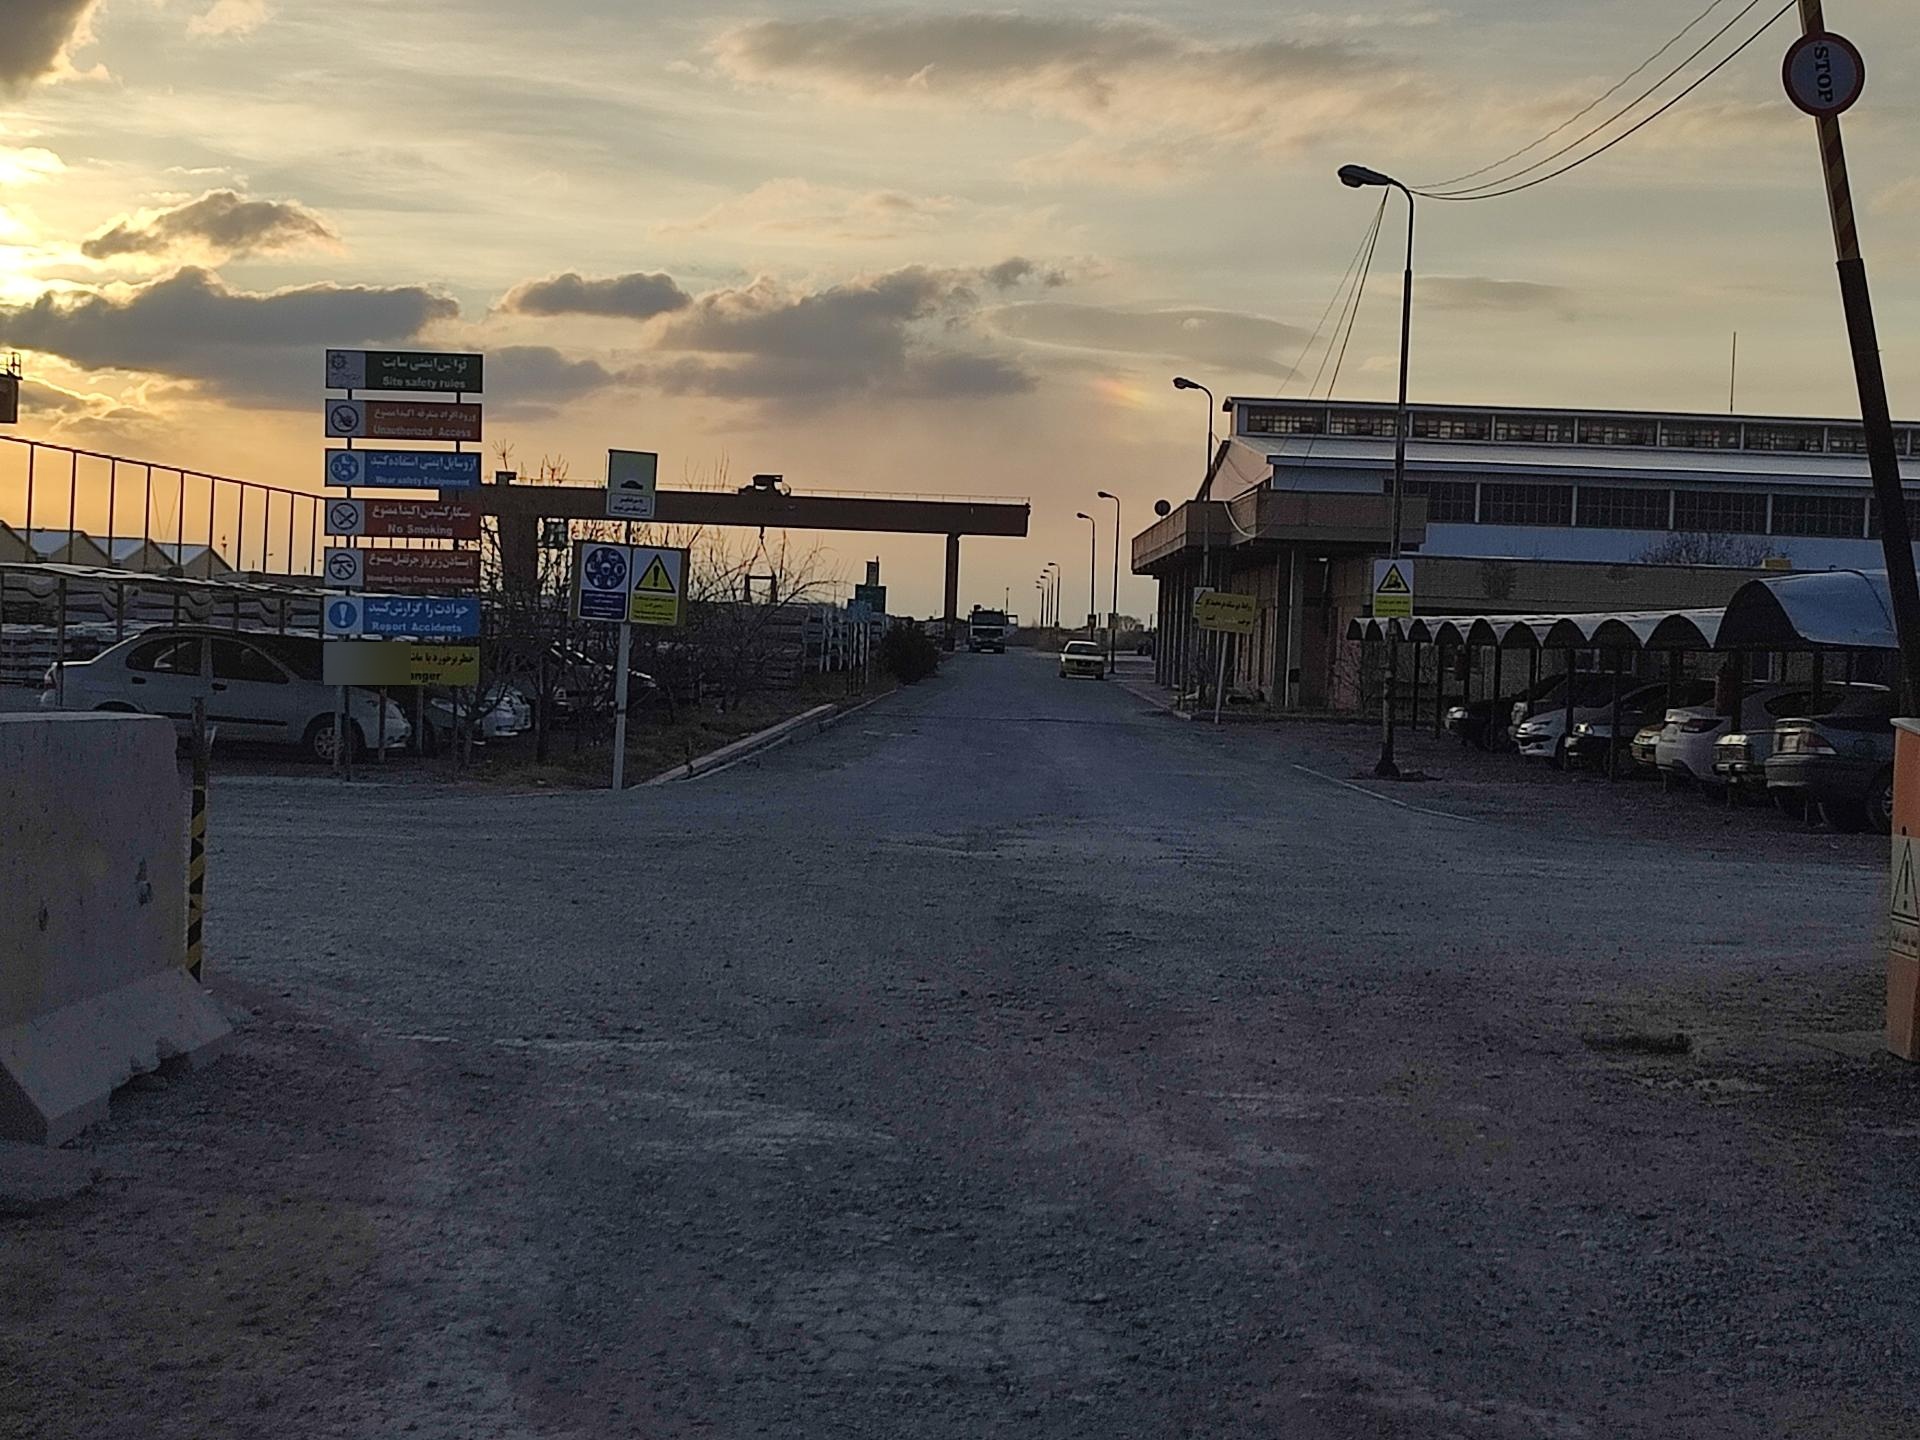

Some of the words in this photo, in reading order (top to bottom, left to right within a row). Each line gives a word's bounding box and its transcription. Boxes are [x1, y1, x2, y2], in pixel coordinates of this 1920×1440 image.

[1814, 46, 1834, 102] STOP
[382, 355, 408, 369] سایت
[410, 357, 437, 371] ایمنی
[382, 375, 403, 387] Site
[405, 377, 437, 390] safety
[439, 379, 466, 389] rules
[373, 424, 434, 437] Unauthorized
[438, 427, 472, 438] Access
[370, 454, 389, 468] کنید
[389, 455, 418, 467] استفاده
[419, 456, 443, 470] ایمنی
[443, 457, 469, 472] وسایل
[372, 504, 397, 519] ممنوع
[420, 505, 450, 519] کشیدن
[387, 523, 403, 534] No
[407, 525, 453, 537] Smoking
[368, 601, 391, 616] کنید
[390, 602, 422, 618] گزارش
[425, 603, 434, 618] را
[435, 603, 469, 618] حوادث
[371, 621, 407, 633] Report
[411, 623, 462, 634] Accidents
[425, 652, 432, 664] با
[433, 654, 458, 666] برخورد
[458, 652, 474, 666] خطر
